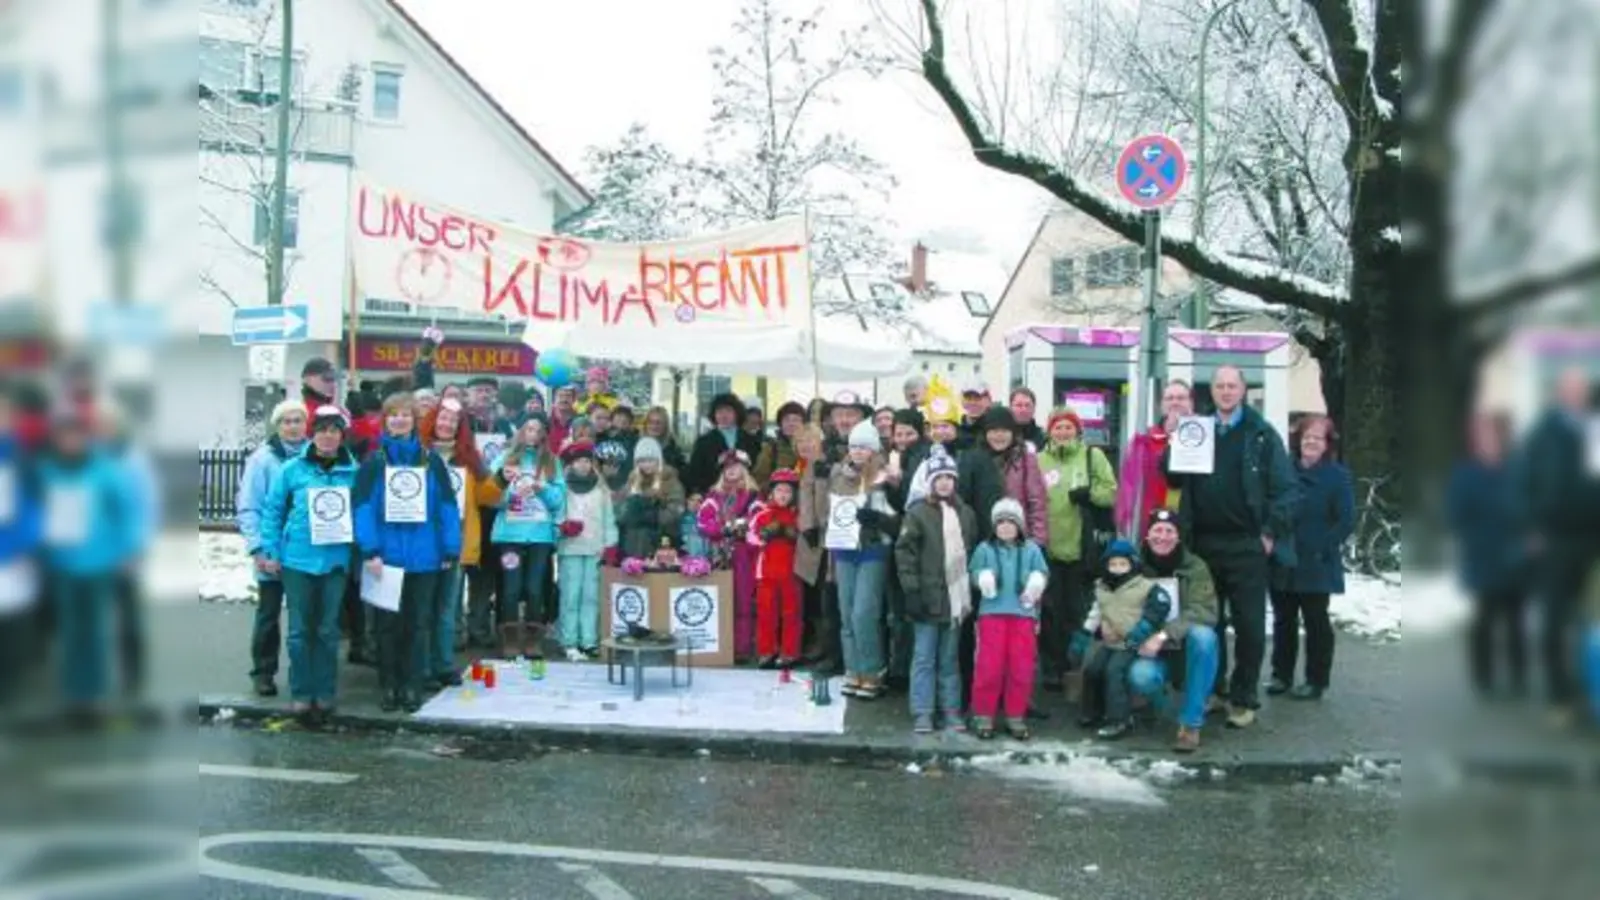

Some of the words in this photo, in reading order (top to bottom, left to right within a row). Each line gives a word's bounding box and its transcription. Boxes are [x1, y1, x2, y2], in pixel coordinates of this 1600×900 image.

[358, 186, 496, 252] UNSER
[482, 254, 657, 326] KLIMA
[373, 344, 521, 368] SB-CKEREI
